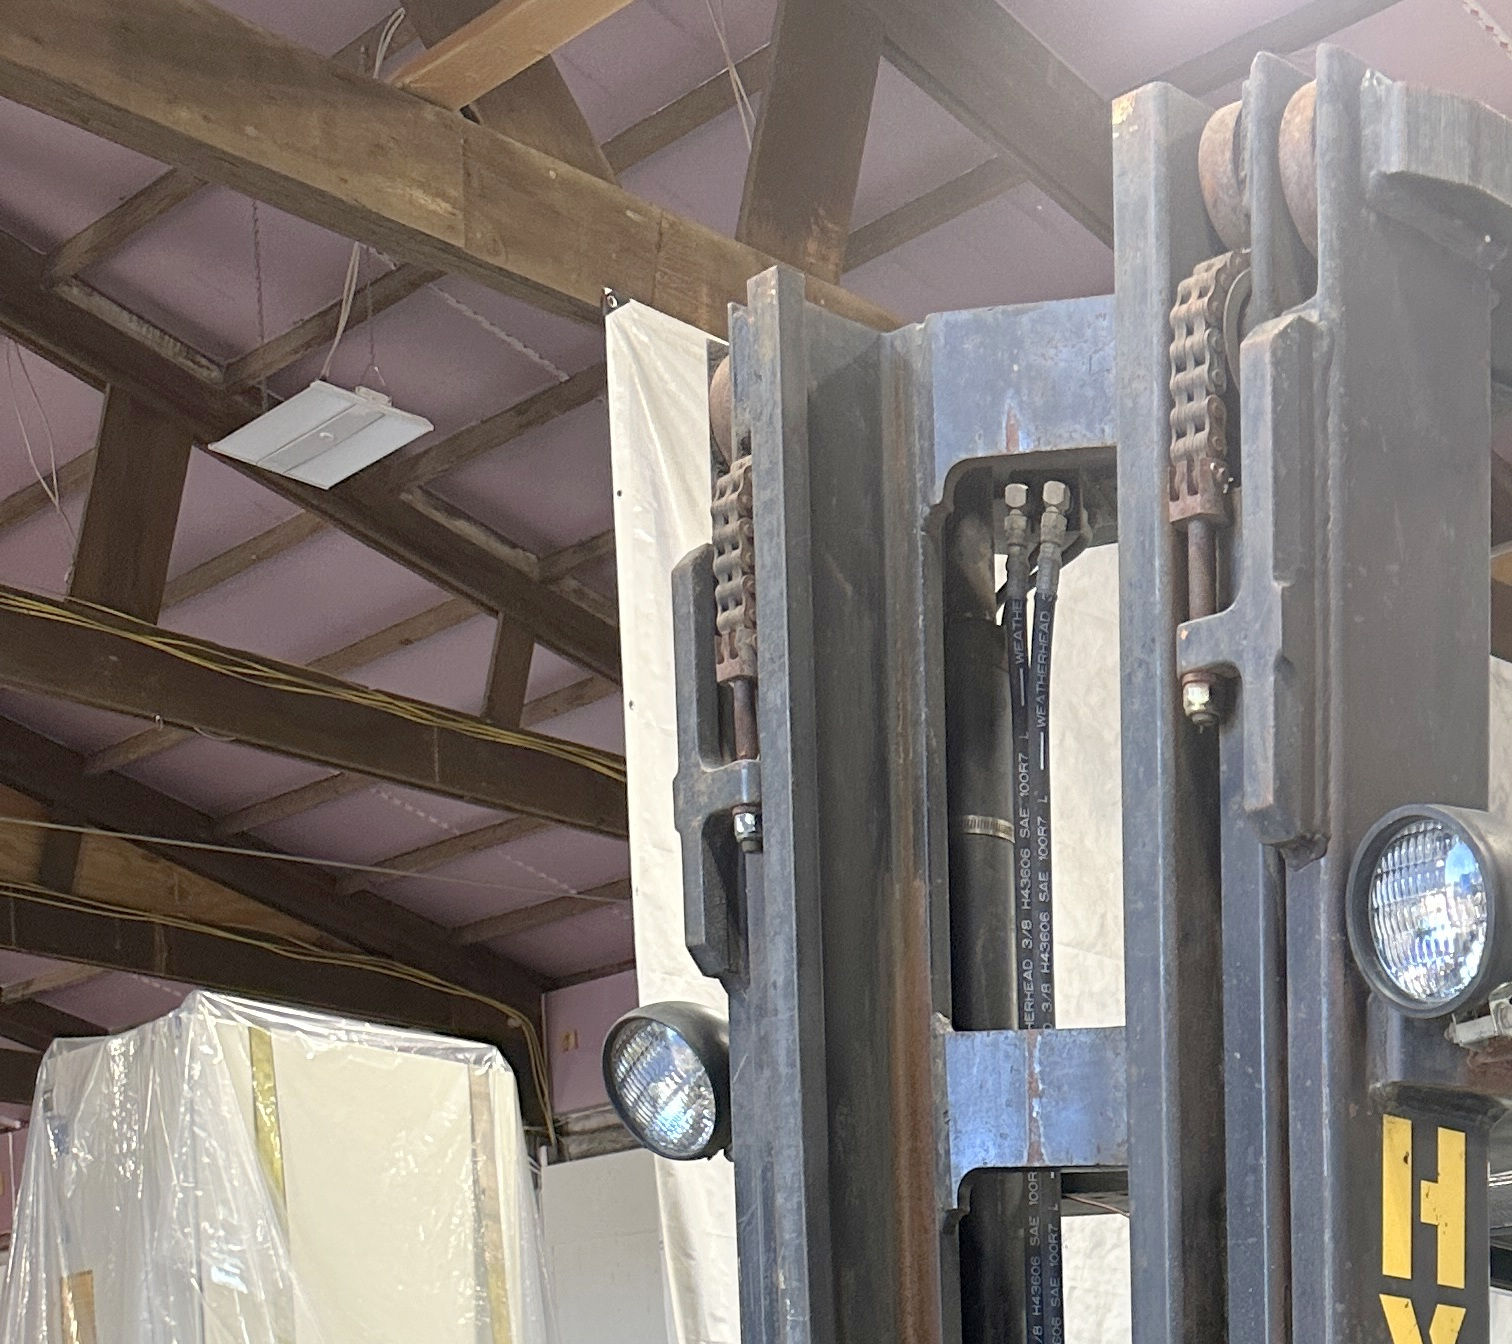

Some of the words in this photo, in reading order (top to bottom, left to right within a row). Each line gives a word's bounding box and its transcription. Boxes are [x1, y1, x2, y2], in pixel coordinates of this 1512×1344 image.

[1035, 610, 1050, 729] WEATHERHEAD
[1018, 752, 1030, 797] 100R7
[1019, 807, 1031, 839] SAE
[1037, 815, 1049, 861] 100R7
[1020, 848, 1032, 910] H43606
[1038, 871, 1050, 903] SAE
[1039, 911, 1051, 974] H43606
